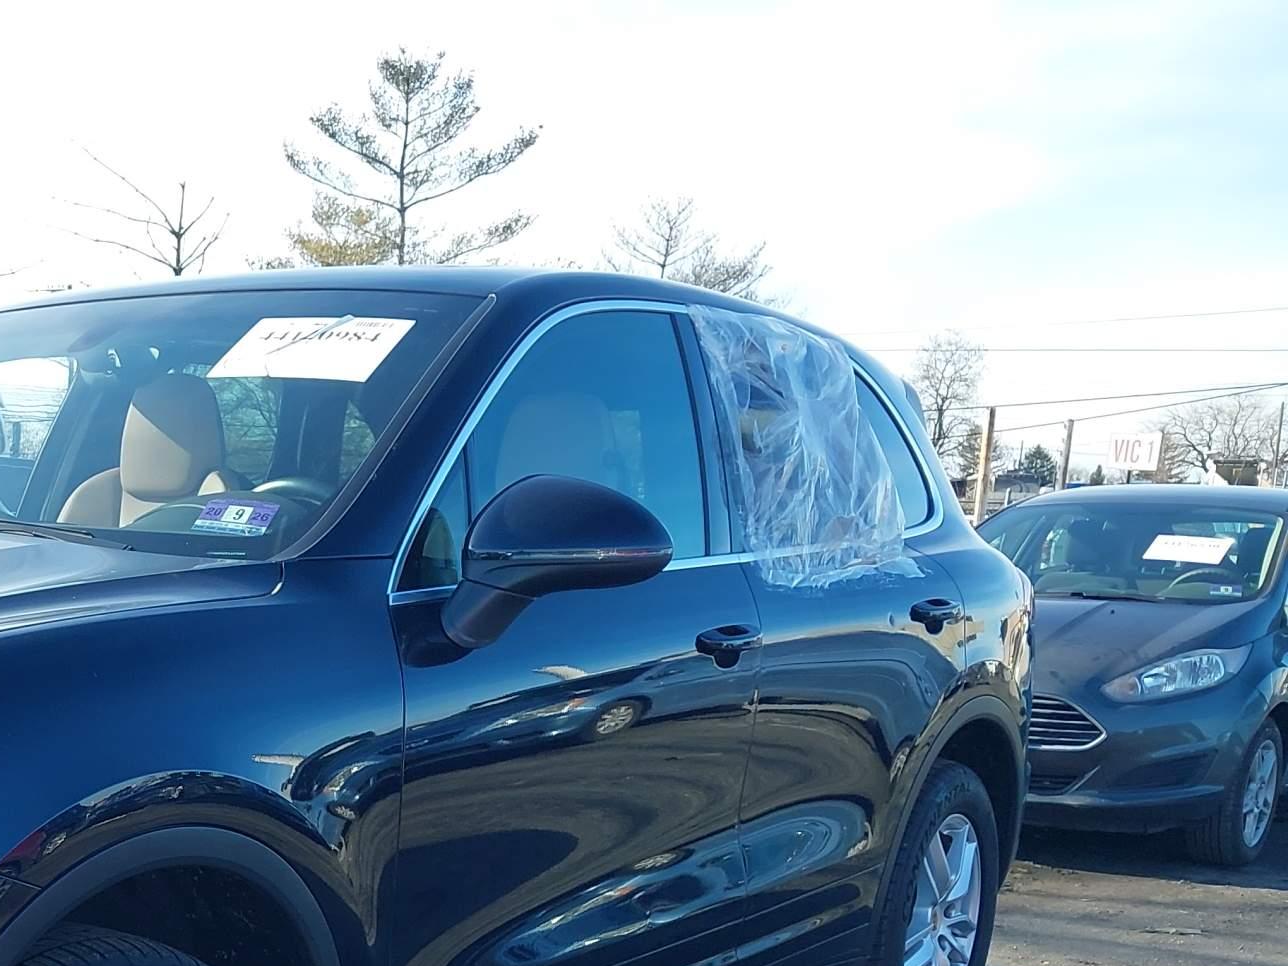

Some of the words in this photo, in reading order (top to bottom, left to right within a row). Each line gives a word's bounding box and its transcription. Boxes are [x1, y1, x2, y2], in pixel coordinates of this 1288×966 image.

[1115, 439, 1141, 463] VIC
[1147, 440, 1154, 464] 1
[205, 507, 223, 516] 20
[232, 509, 245, 521] 9
[251, 512, 272, 522] 26
